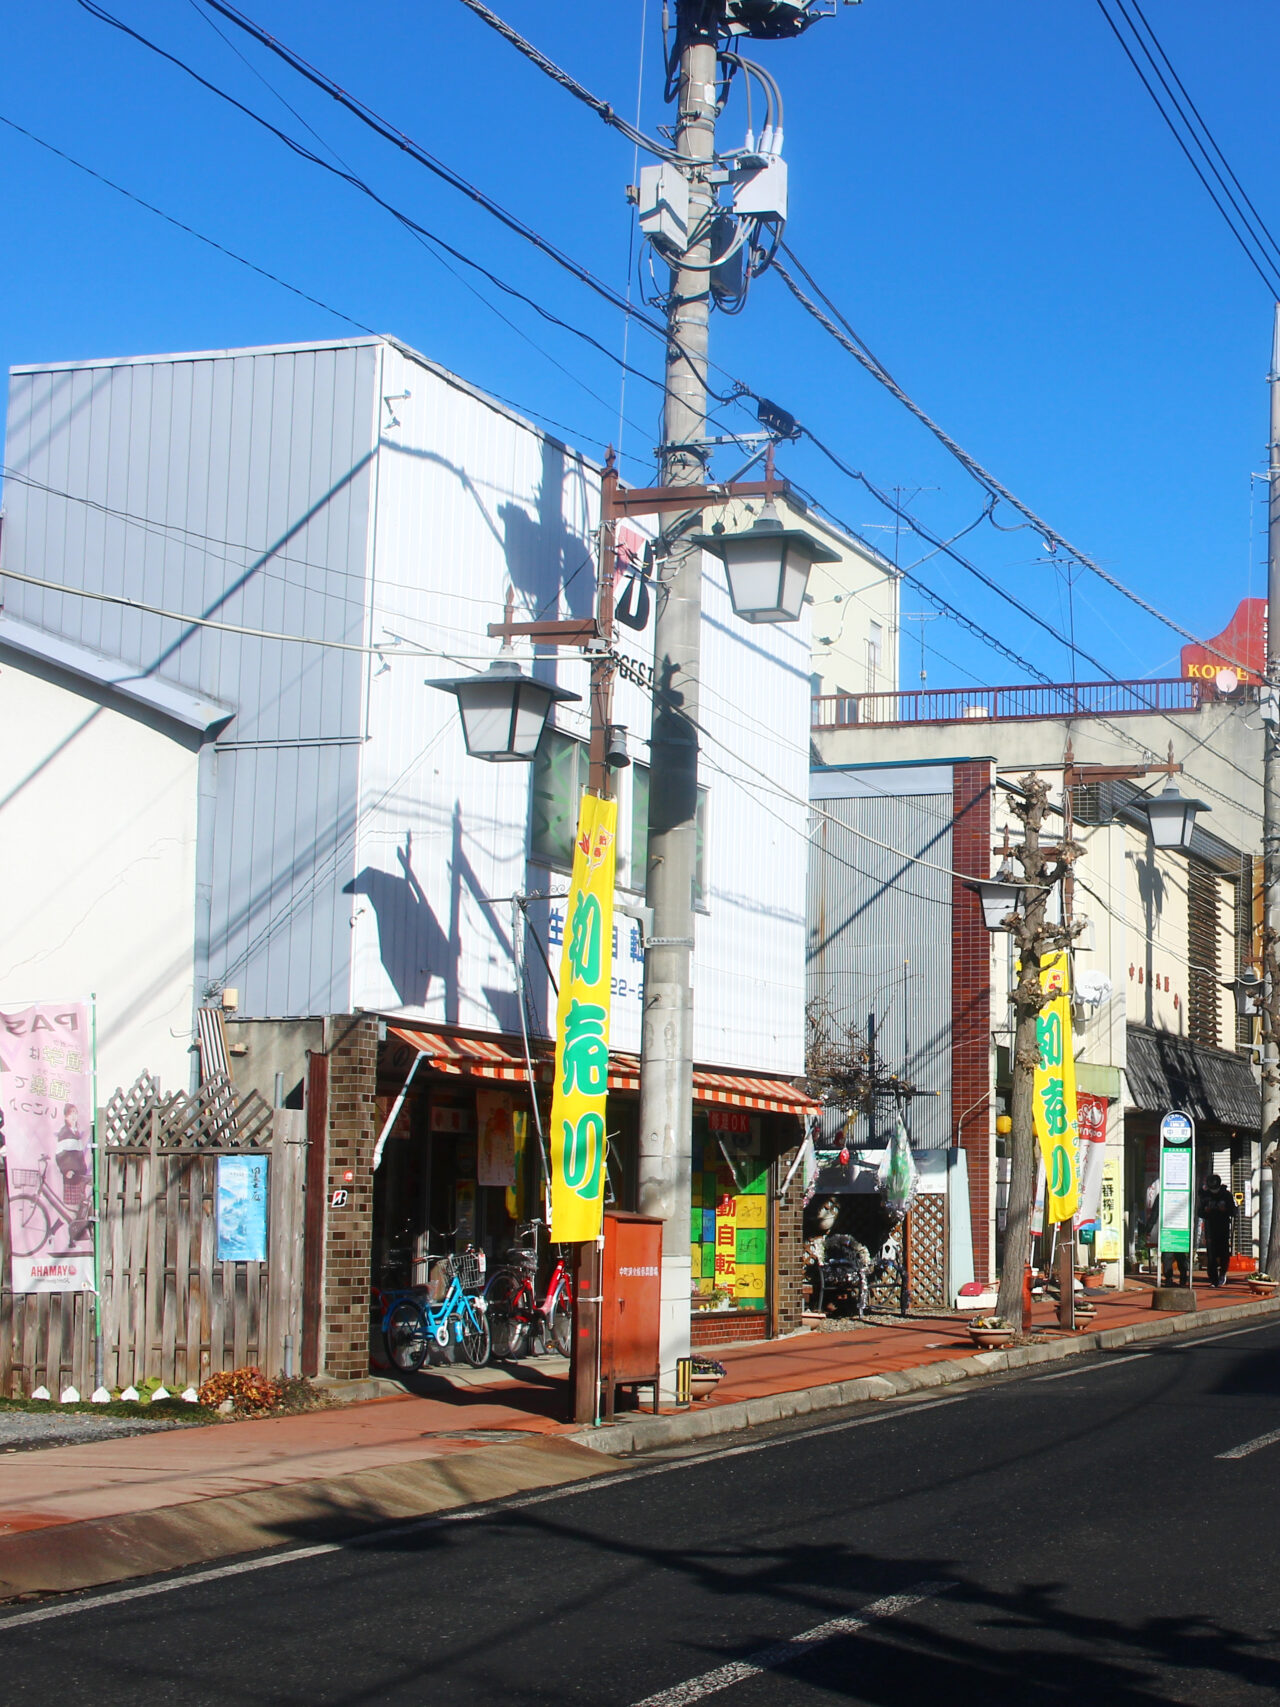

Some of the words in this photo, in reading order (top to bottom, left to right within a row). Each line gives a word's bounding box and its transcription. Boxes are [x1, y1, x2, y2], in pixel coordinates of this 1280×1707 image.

[563, 888, 608, 1199] 初売り
[1101, 1177, 1115, 1225] 一番搾り
